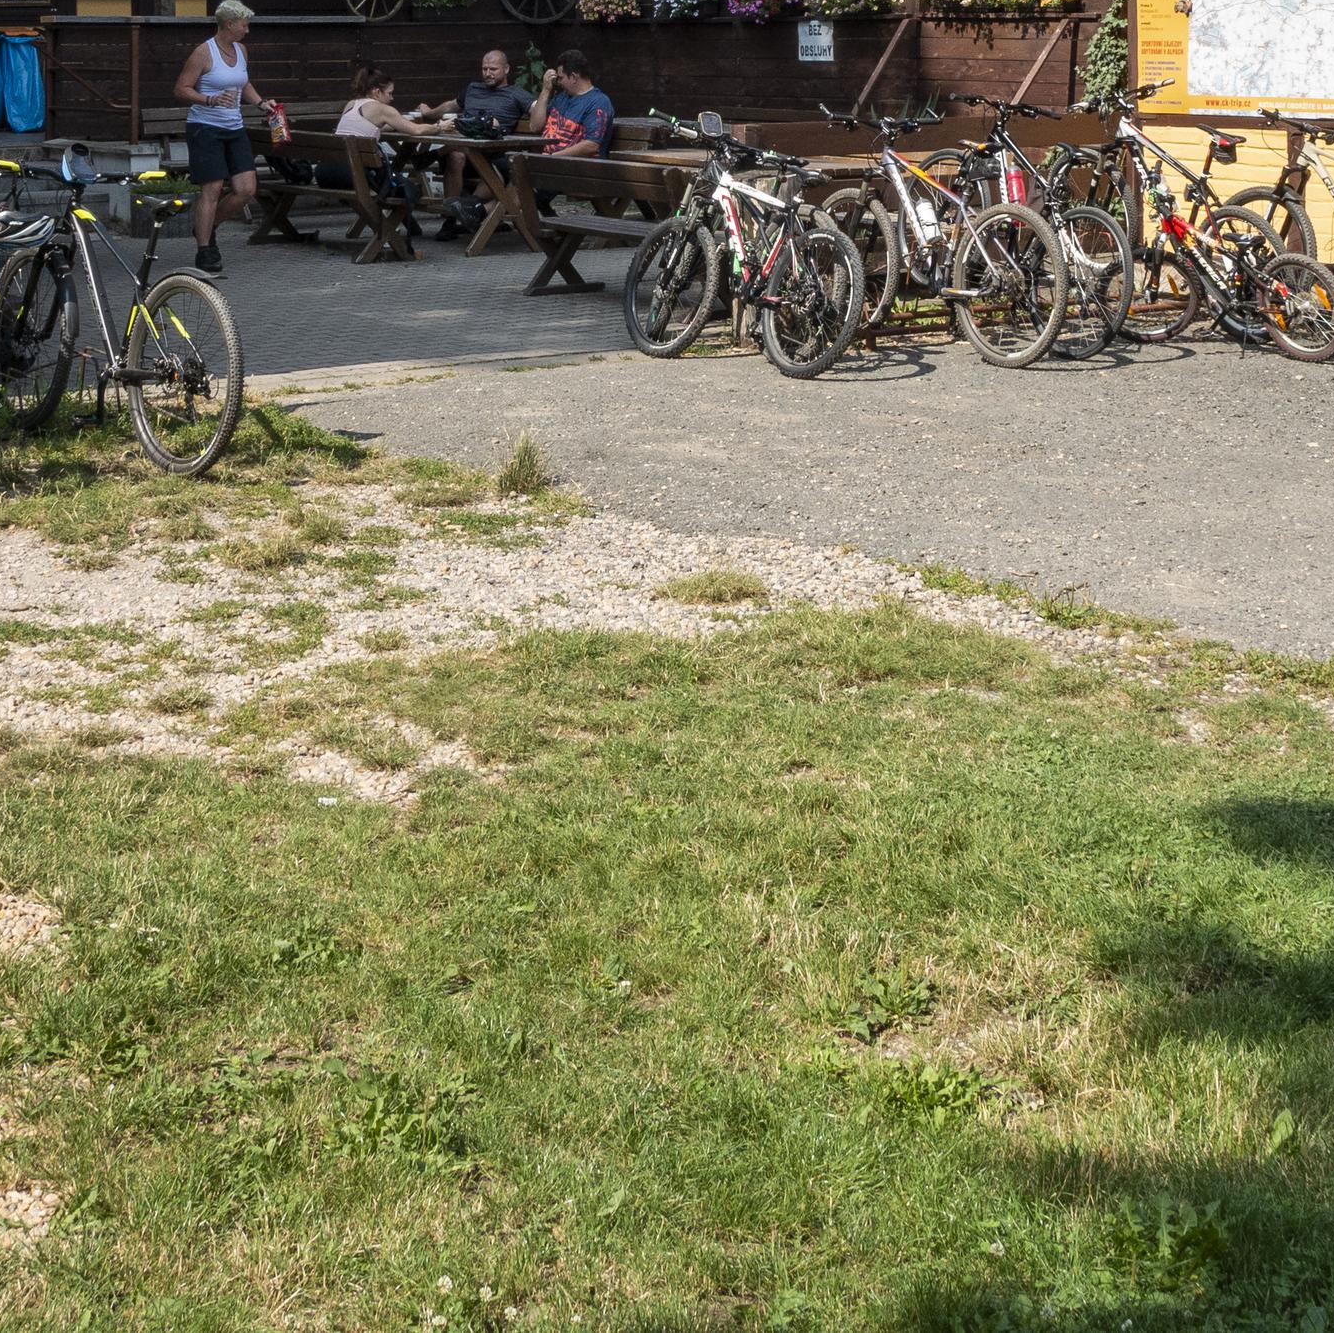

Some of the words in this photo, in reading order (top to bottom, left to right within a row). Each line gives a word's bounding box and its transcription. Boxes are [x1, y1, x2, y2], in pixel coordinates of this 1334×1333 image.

[808, 24, 822, 36] BEZ
[800, 45, 832, 57] OBSLUHY
[1205, 98, 1251, 108] www.ck-trip.cz
